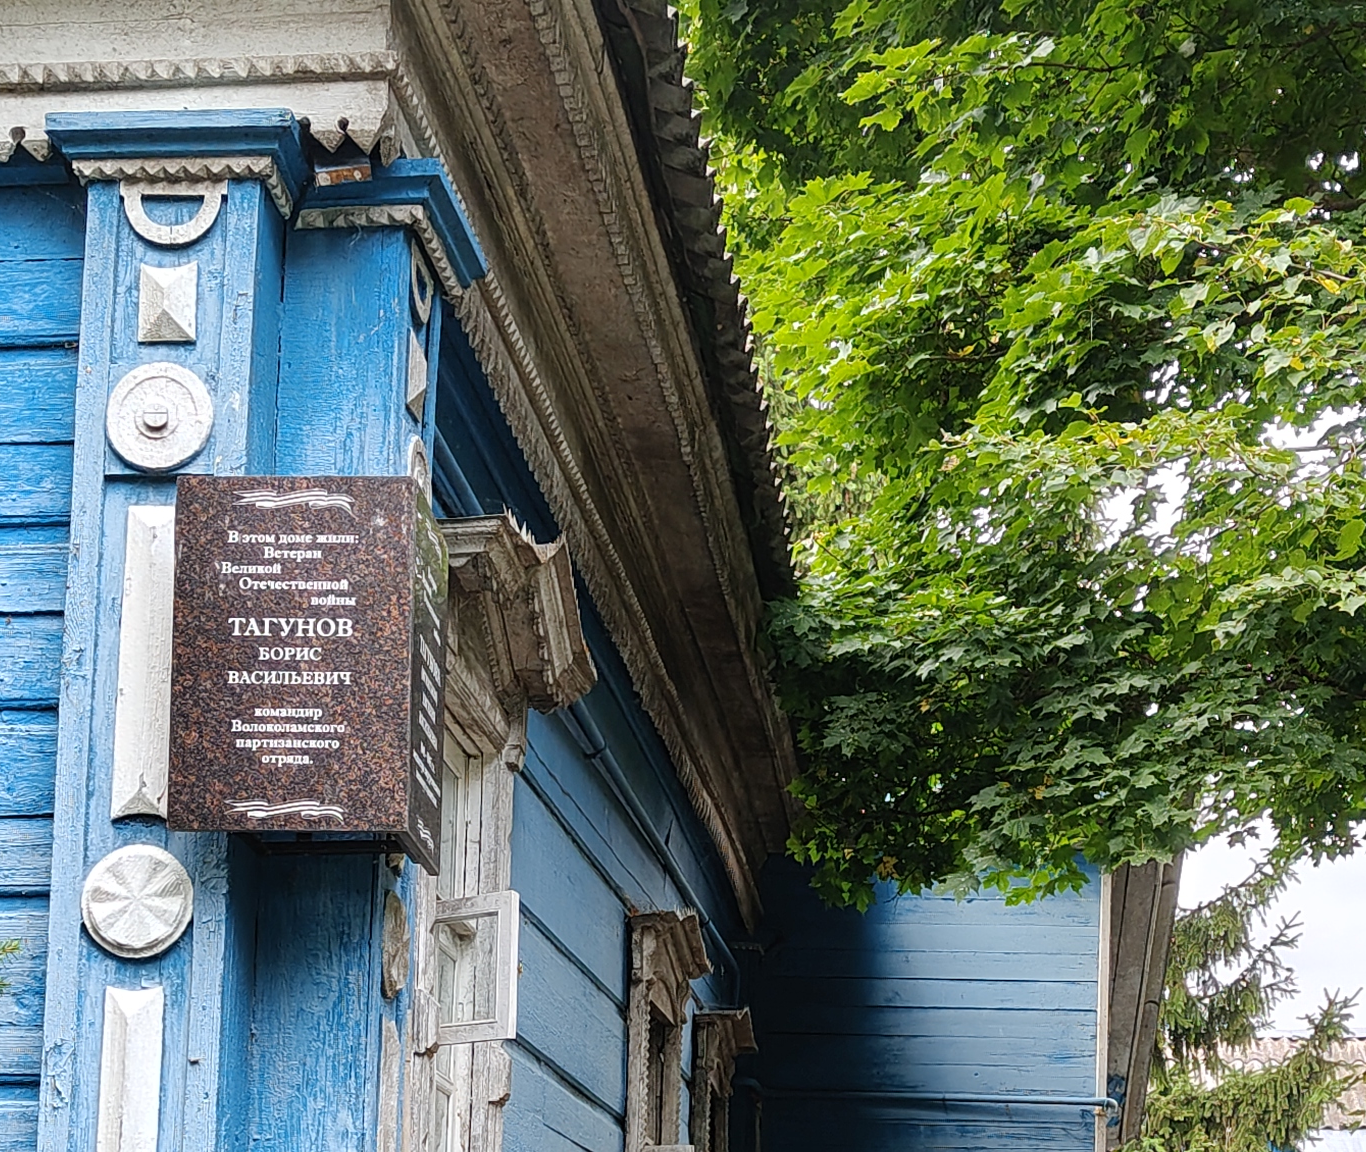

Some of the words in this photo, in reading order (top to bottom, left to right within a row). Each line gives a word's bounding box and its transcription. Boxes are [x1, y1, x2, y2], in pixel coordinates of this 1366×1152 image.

[227, 530, 239, 543] В
[242, 533, 276, 543] этом
[278, 533, 313, 544] доме
[263, 546, 322, 562] Ветеран
[221, 561, 282, 574] Великой
[239, 577, 349, 590] Отечественной
[310, 594, 357, 606] войны
[227, 617, 354, 637] ТАГУНОВ
[258, 647, 322, 660] БОРИС
[227, 670, 352, 685] ВАСИЛЬЕВИЧ
[254, 708, 323, 720] командир
[230, 720, 345, 733] Волоколамского
[235, 739, 340, 751] партизанского
[261, 755, 314, 767] отряда.
